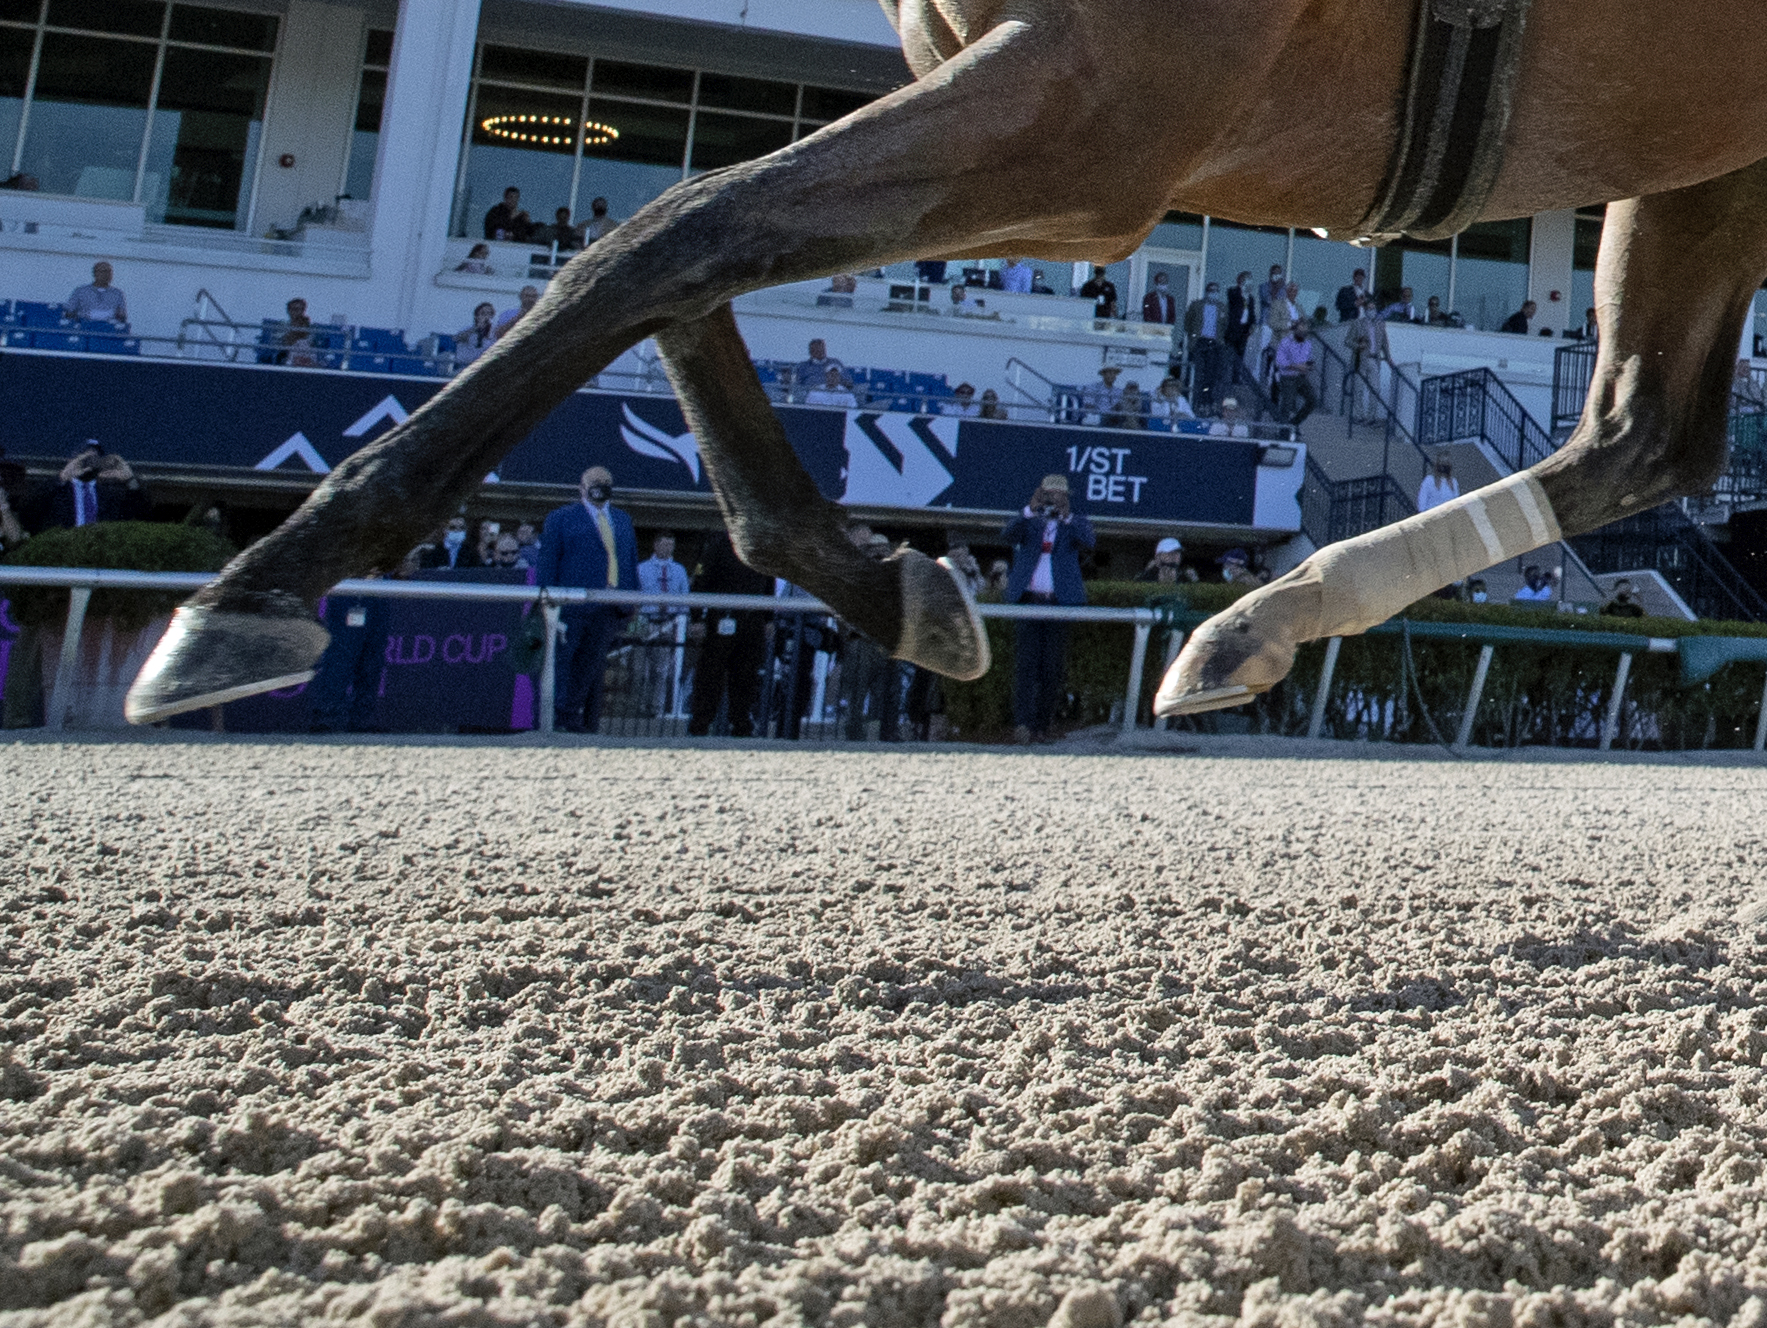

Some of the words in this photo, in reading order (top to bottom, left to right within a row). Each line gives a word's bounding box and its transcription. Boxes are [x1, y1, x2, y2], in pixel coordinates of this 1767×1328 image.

[1066, 445, 1132, 475] 1/ST
[1086, 474, 1149, 503] BET
[441, 633, 508, 663] CUP
